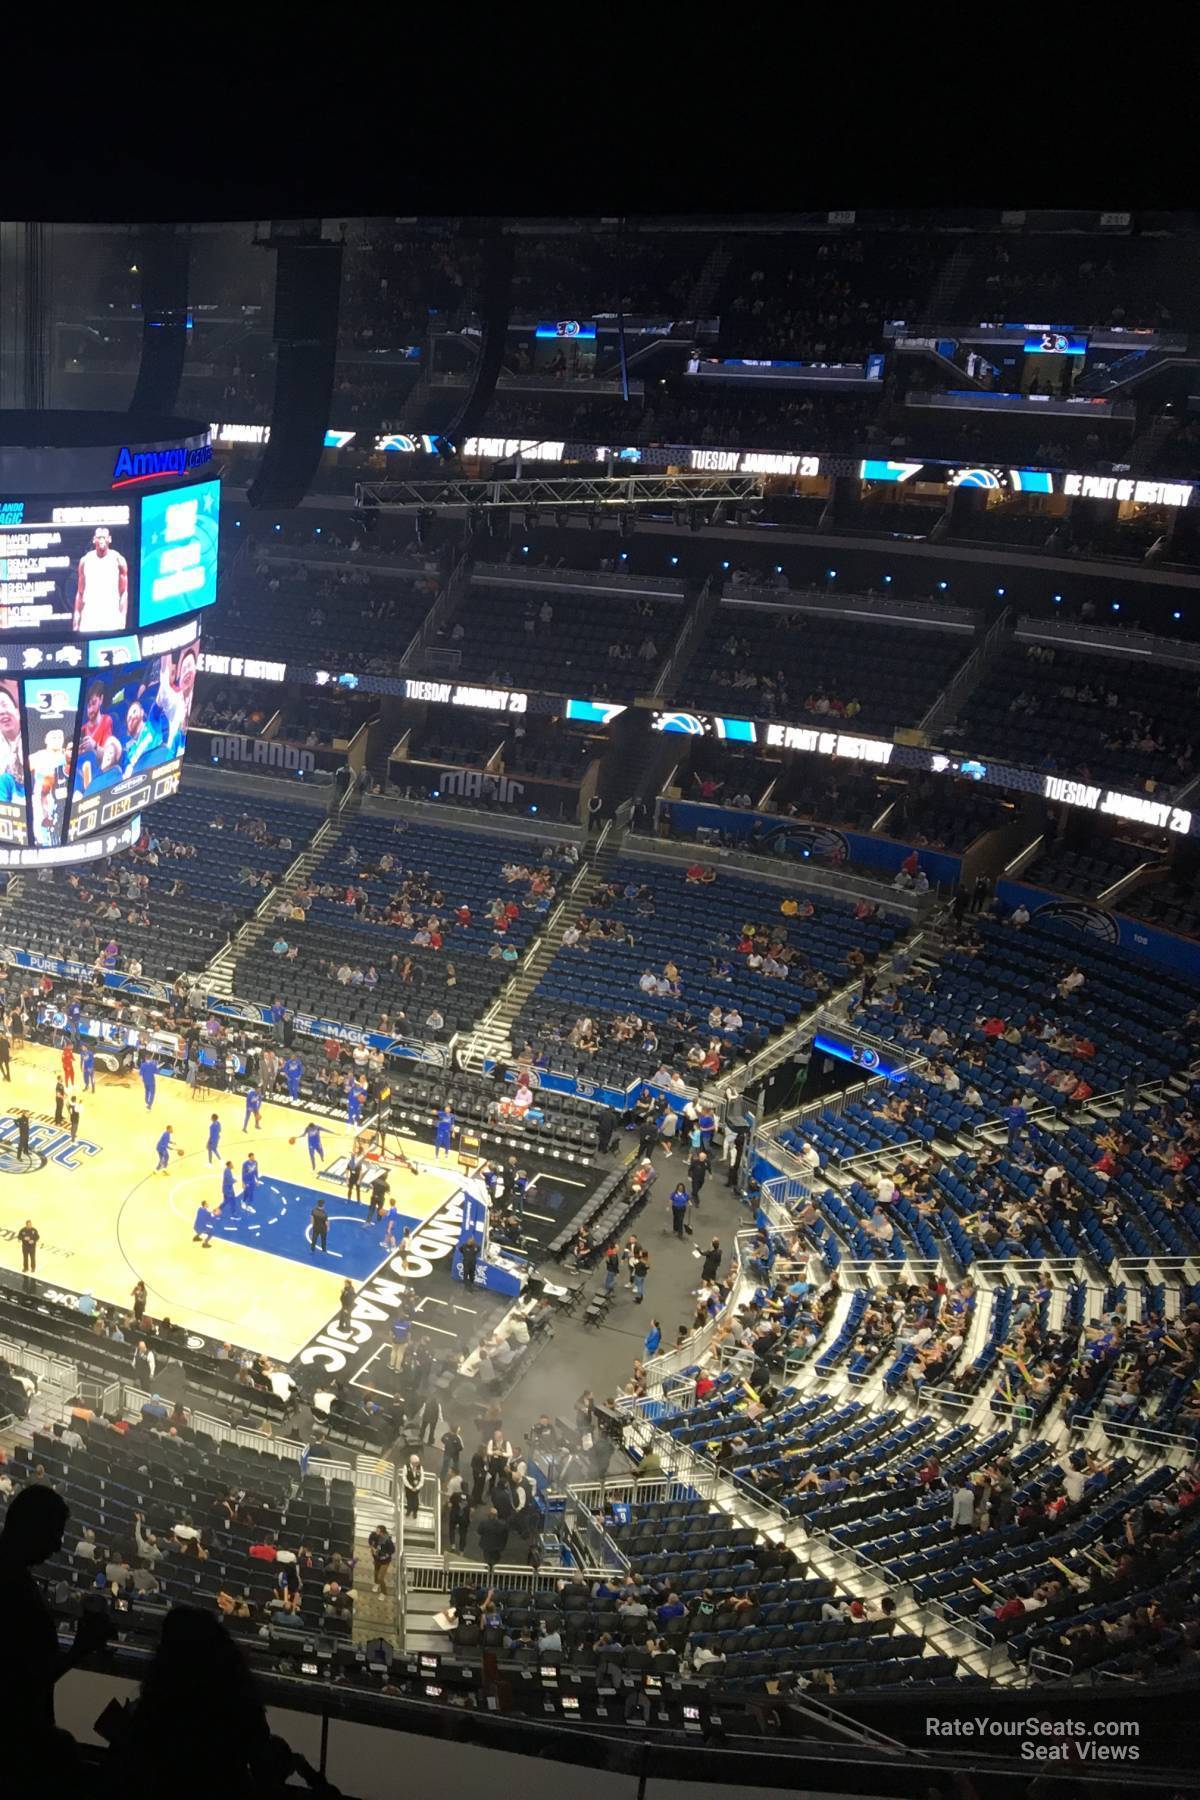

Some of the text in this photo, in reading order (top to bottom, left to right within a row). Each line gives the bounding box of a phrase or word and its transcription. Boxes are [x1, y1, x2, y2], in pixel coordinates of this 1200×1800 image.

[113, 447, 187, 477] Amway
[691, 450, 740, 470] TUESDAY
[741, 453, 800, 474] JANUARY
[1064, 474, 1193, 506] BE PART OF HISTORY
[205, 655, 231, 674] PART
[244, 659, 286, 681] HISTORY
[406, 680, 452, 703] TUESDAY
[453, 686, 509, 710] JANUARY
[211, 736, 315, 772] ORLANDO
[767, 724, 894, 764] BE PART OF HISTORY
[1044, 776, 1101, 810] TUESDAY
[1101, 791, 1172, 827] JANUARY
[30, 956, 58, 972] PURE
[327, 1026, 370, 1044] MAGIC
[300, 1277, 406, 1373] MAGIC
